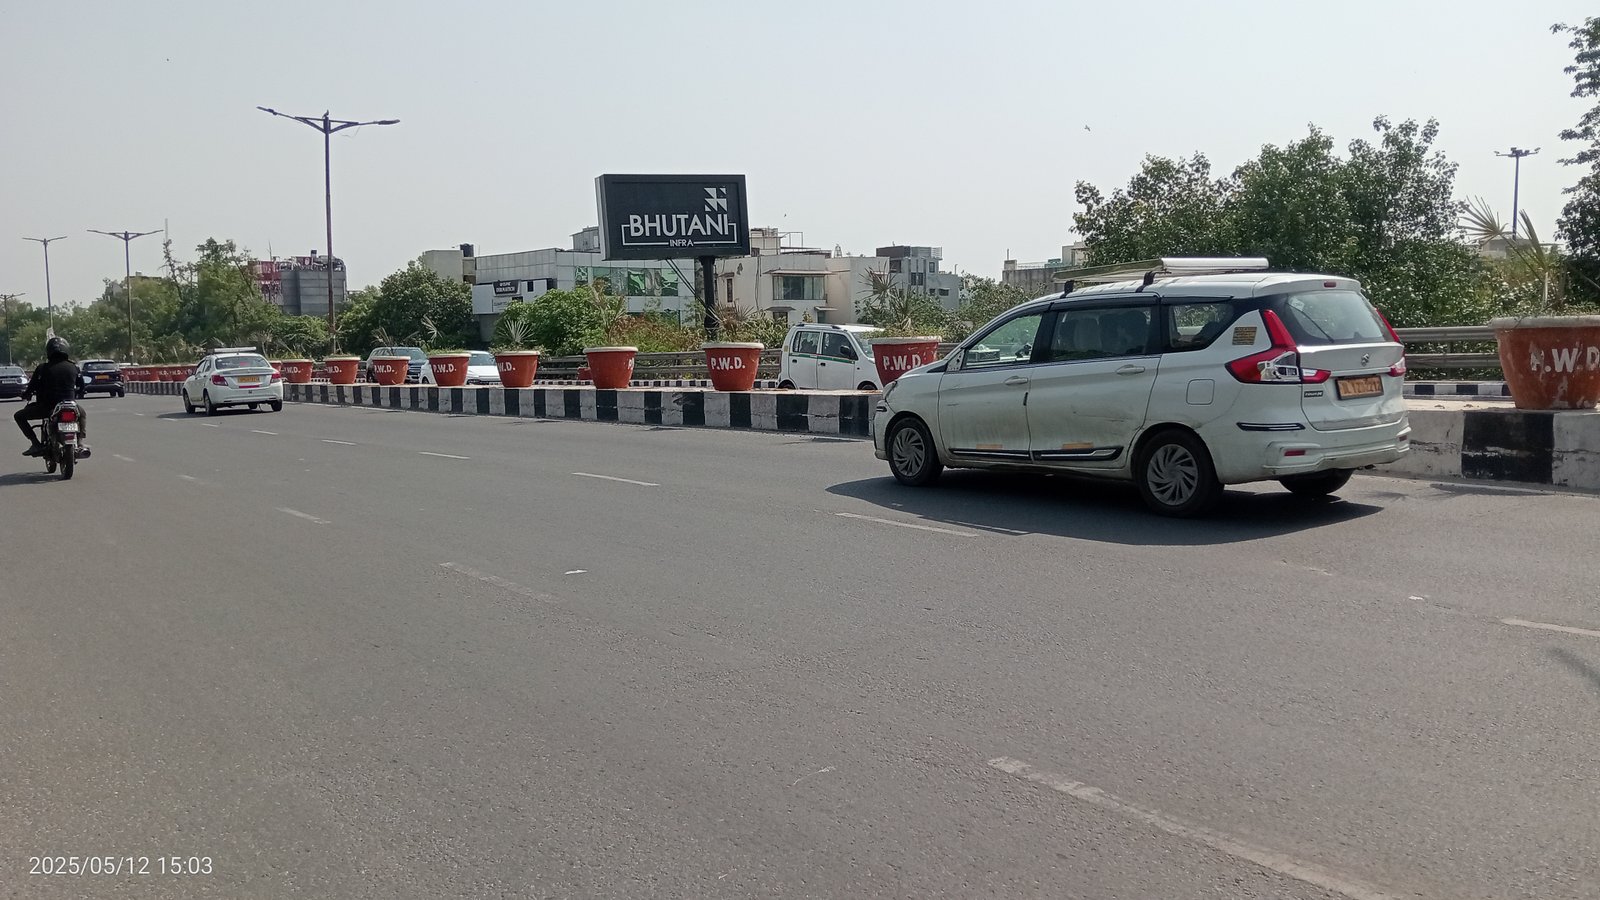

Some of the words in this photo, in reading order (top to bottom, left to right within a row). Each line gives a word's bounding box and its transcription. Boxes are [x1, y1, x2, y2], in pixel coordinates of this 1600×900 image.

[629, 213, 730, 237] BHUTANI
[669, 238, 694, 247] INFRA
[710, 356, 746, 371] P.W.D.
